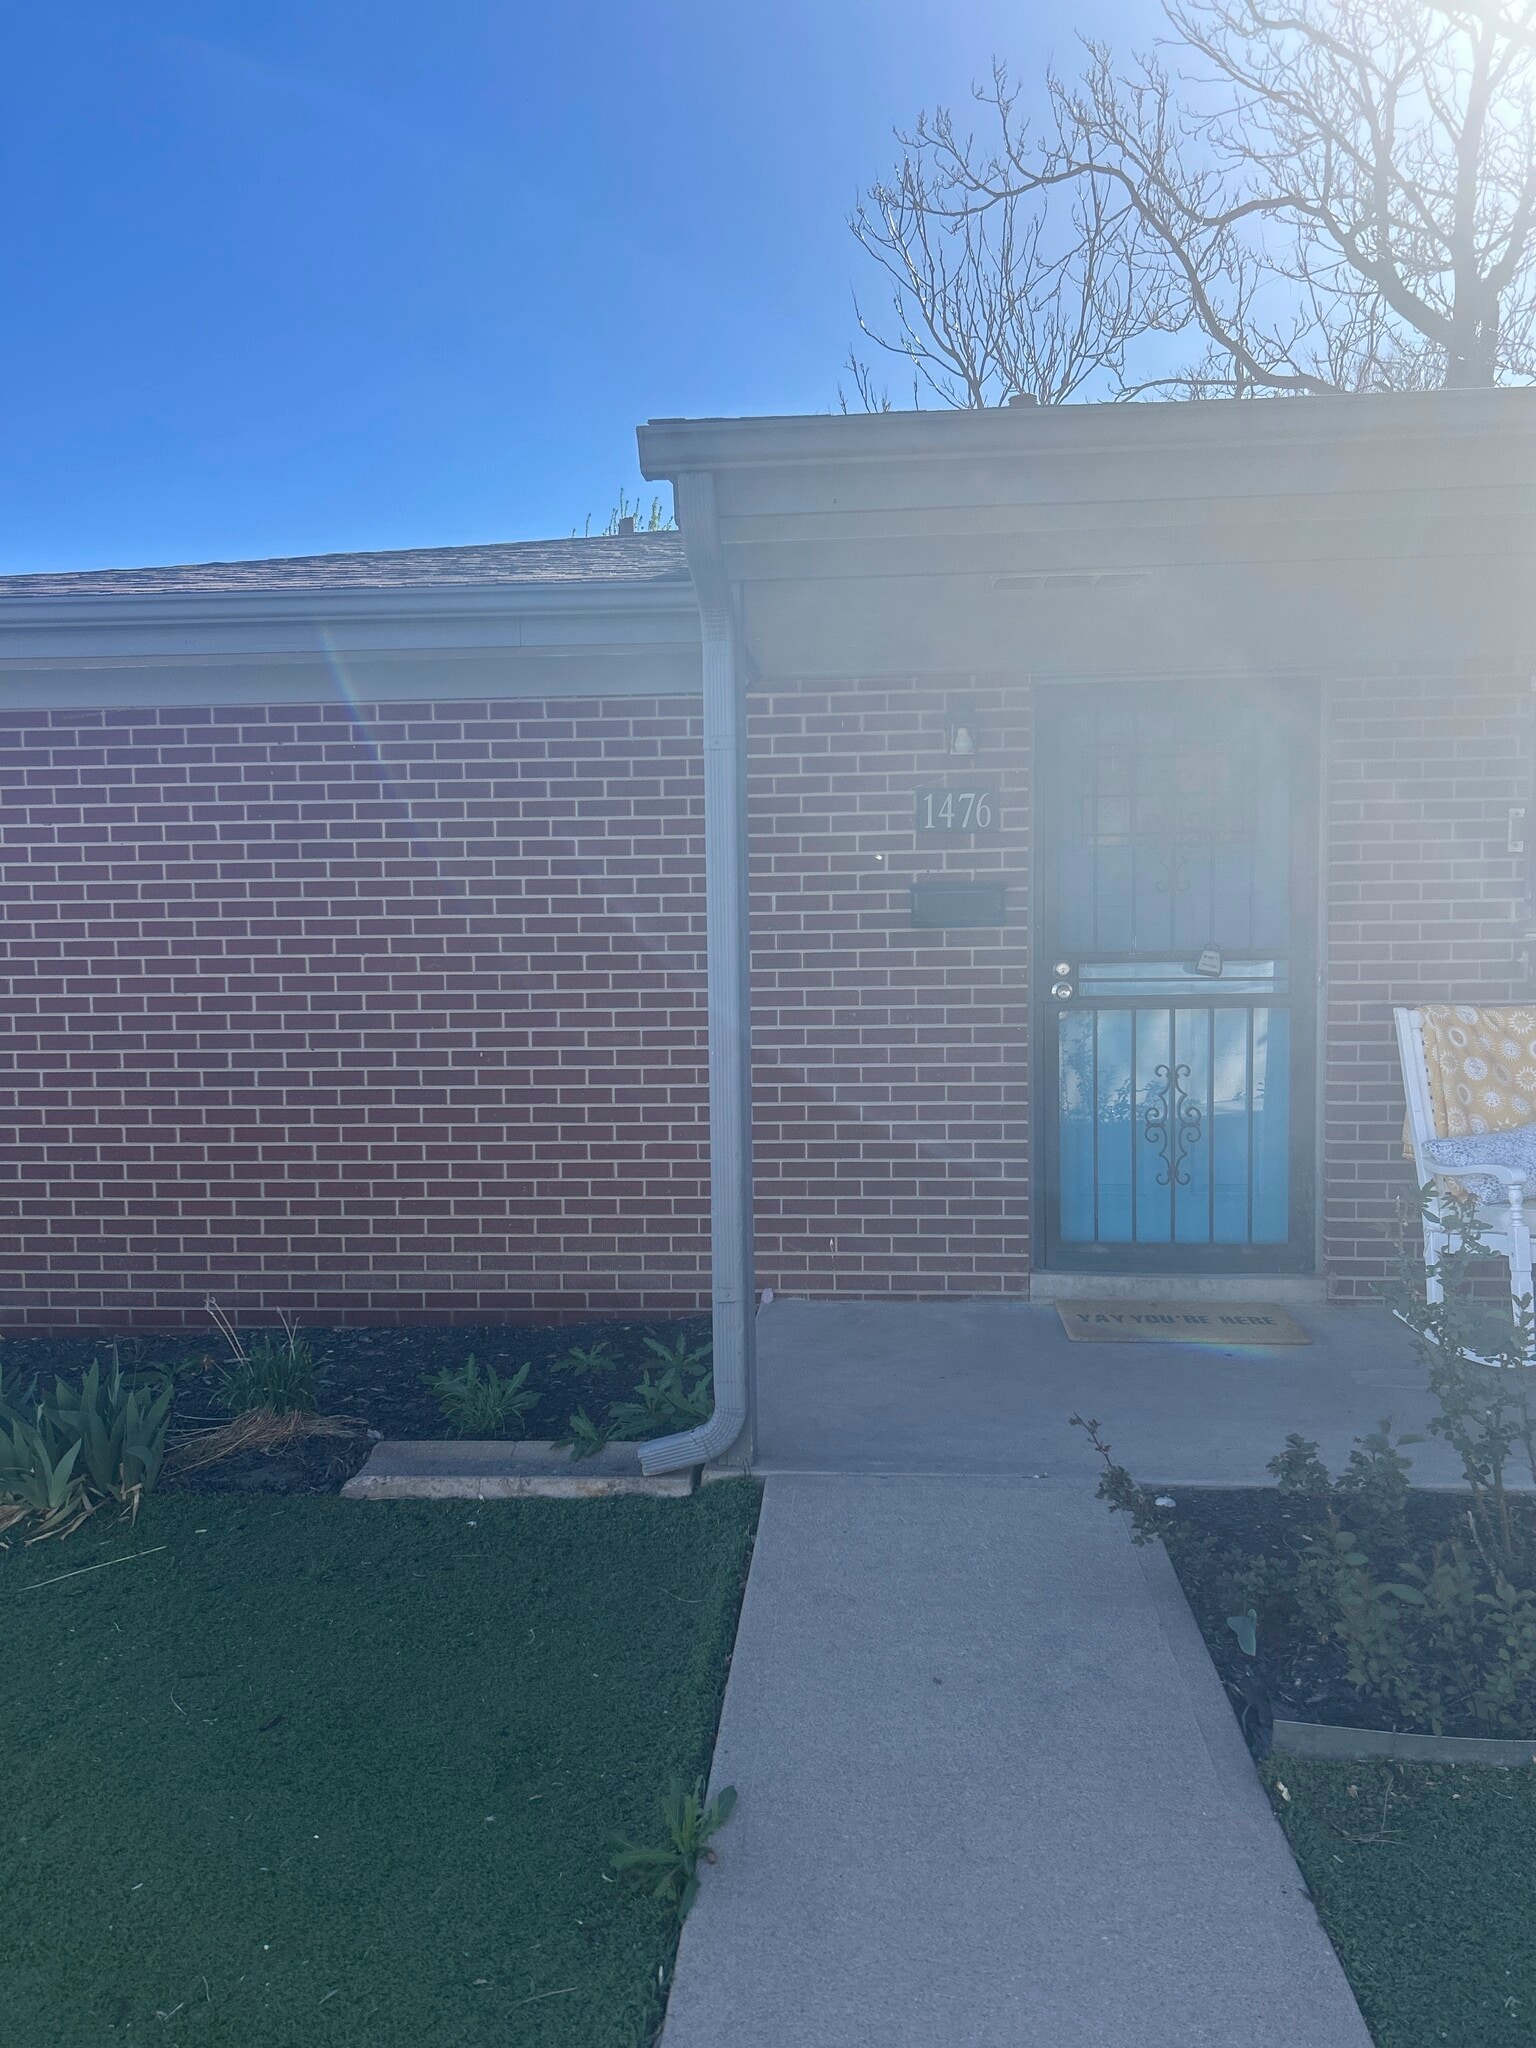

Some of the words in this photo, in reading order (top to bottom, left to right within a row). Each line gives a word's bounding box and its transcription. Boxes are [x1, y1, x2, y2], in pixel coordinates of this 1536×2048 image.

[923, 792, 992, 829] 1476
[1076, 1313, 1124, 1324] YAY
[1128, 1314, 1213, 1325] YOU'RE
[1218, 1315, 1279, 1326] HERE
